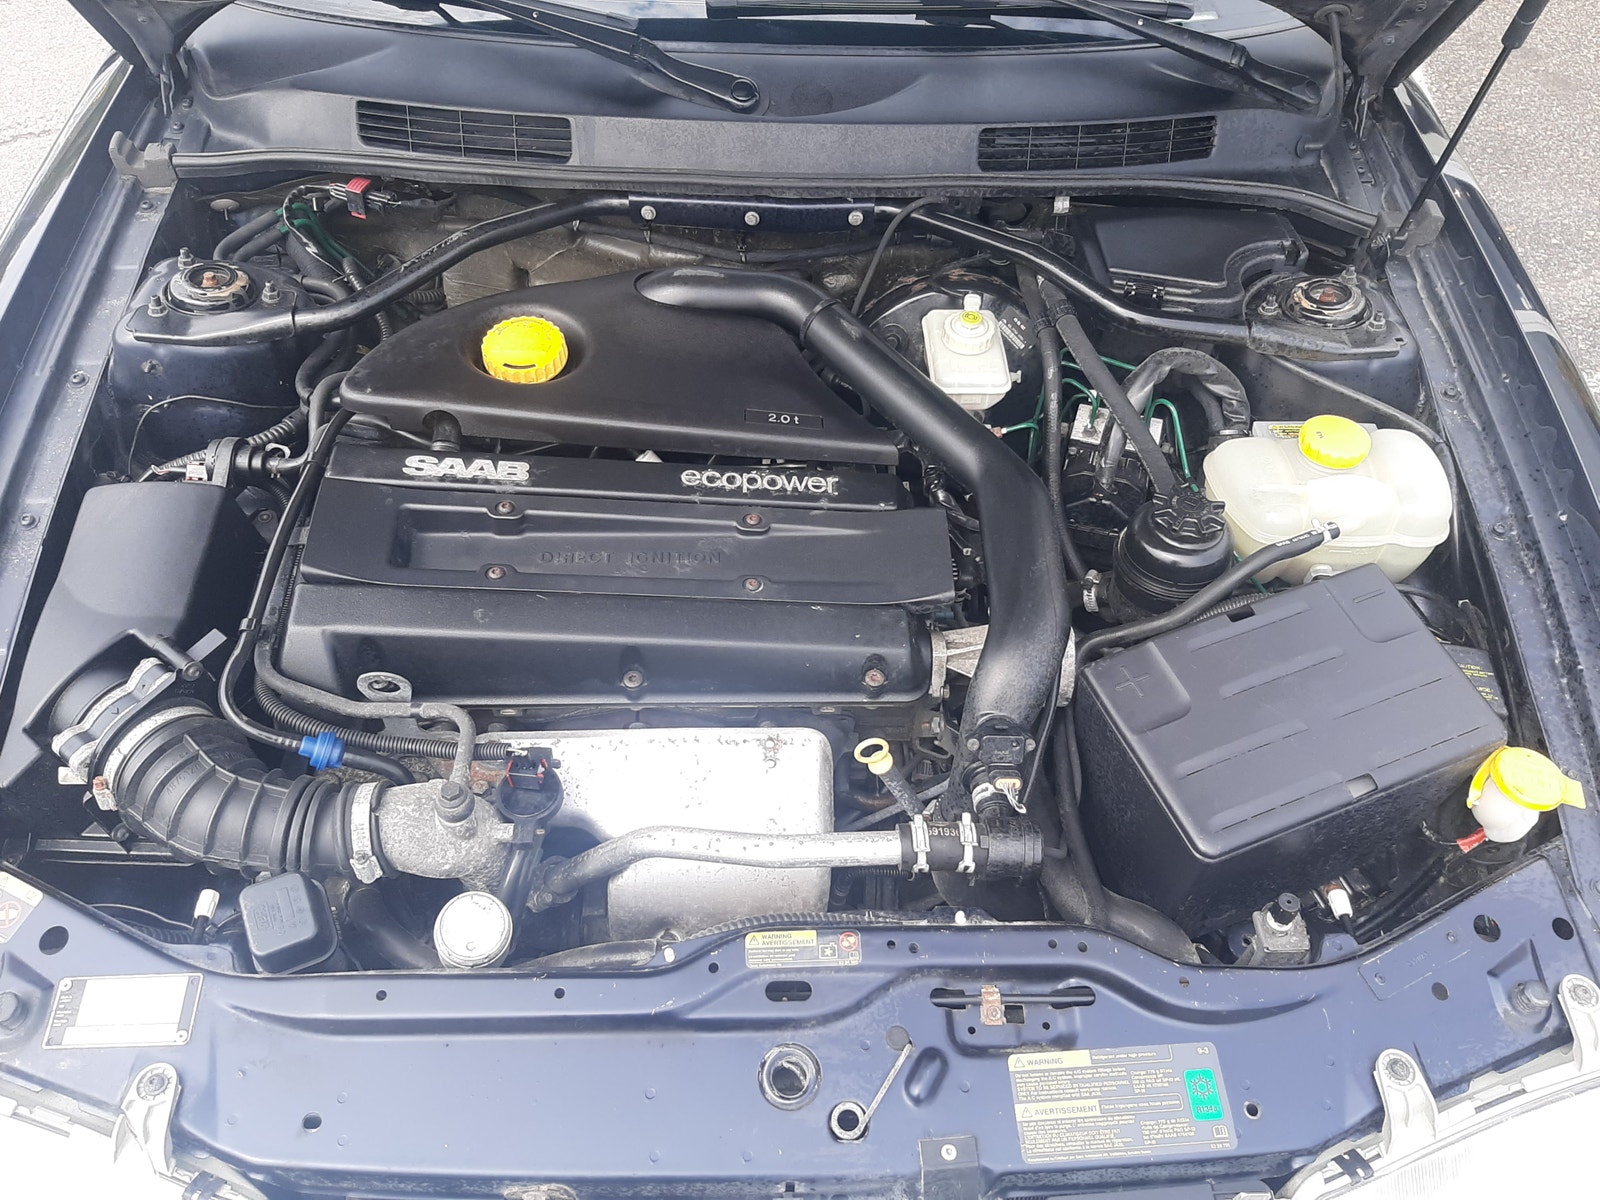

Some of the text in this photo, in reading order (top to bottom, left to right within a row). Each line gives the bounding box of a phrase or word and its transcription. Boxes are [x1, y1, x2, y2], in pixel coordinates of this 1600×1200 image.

[768, 413, 800, 425] 2.0 t
[402, 454, 531, 482] SAAB
[680, 469, 839, 495] ecopower
[539, 550, 723, 566] DIRECT IGNITION
[1026, 1058, 1063, 1066] WARNING
[1034, 1105, 1098, 1116] AVERTISSEMENT
